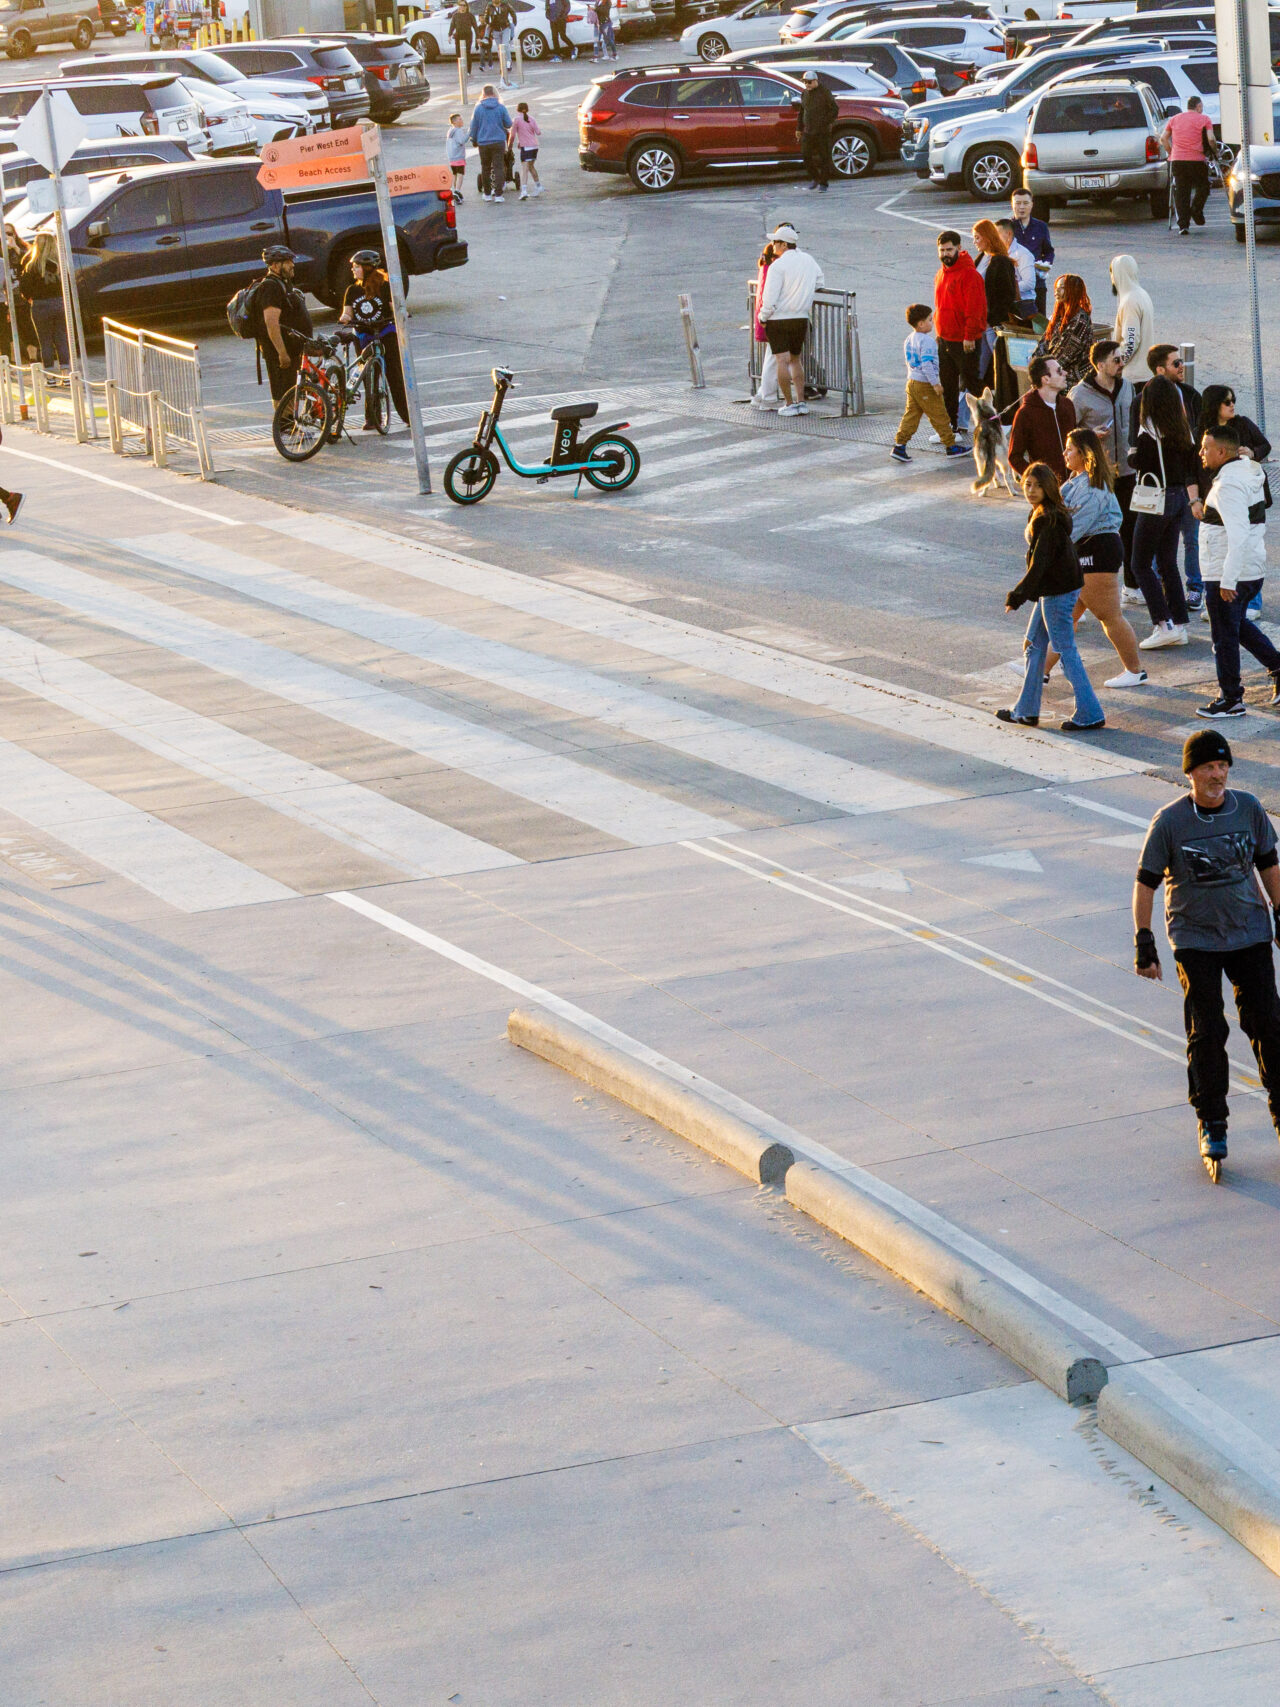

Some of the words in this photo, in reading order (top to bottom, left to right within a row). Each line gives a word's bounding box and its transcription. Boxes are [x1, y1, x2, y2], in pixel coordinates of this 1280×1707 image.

[299, 145, 314, 153] Pier
[316, 141, 334, 150] West
[335, 138, 349, 147] End
[298, 168, 322, 177] Beach
[325, 165, 352, 175] Access
[394, 172, 417, 182] Beach
[559, 428, 572, 456] veo
